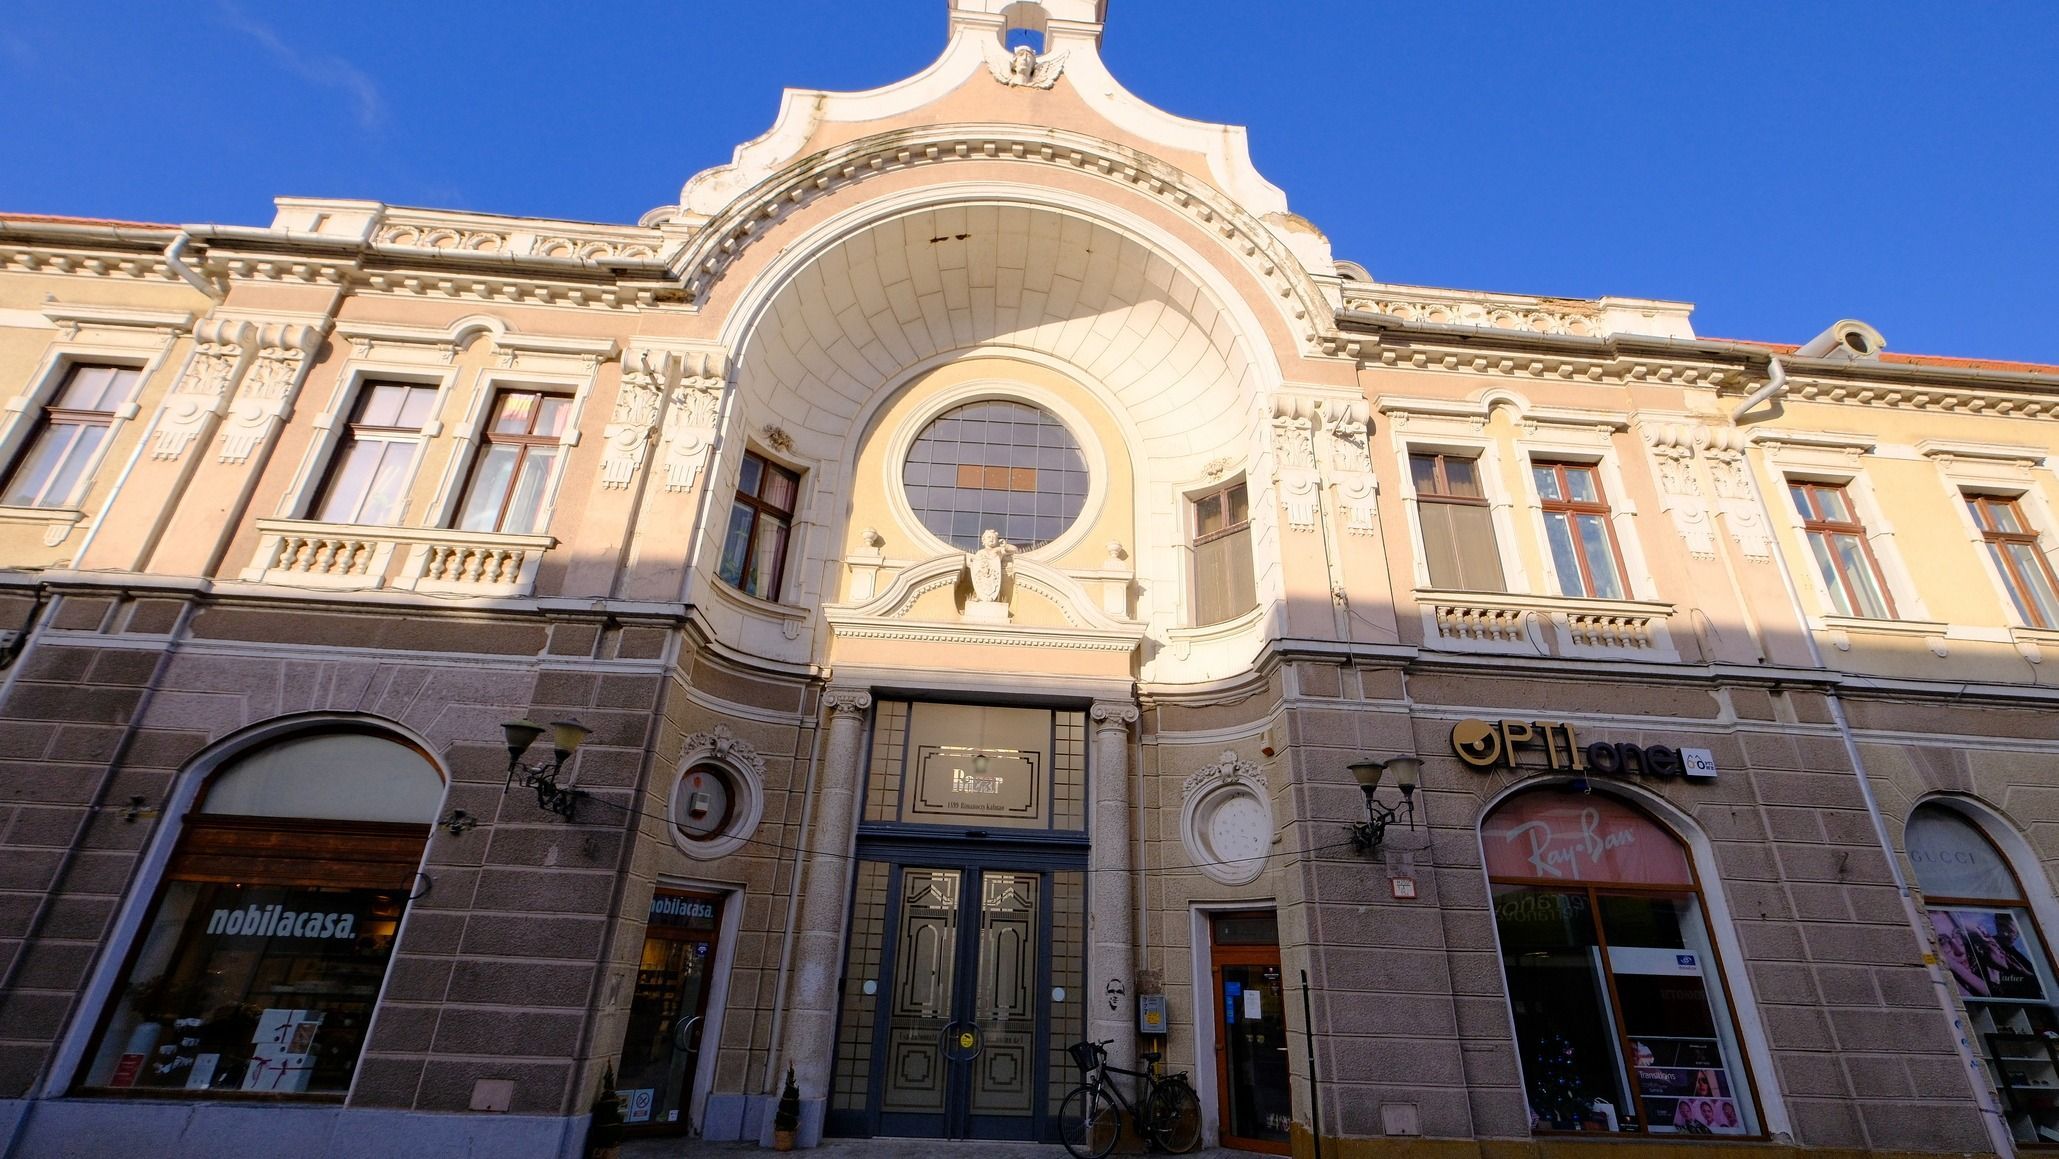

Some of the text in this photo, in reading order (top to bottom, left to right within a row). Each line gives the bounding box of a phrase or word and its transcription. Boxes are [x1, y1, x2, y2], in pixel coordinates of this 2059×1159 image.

[1451, 718, 1679, 777] OPTI one
[1506, 807, 1636, 881] Ray-Ban
[1910, 850, 1976, 865] GUCCI
